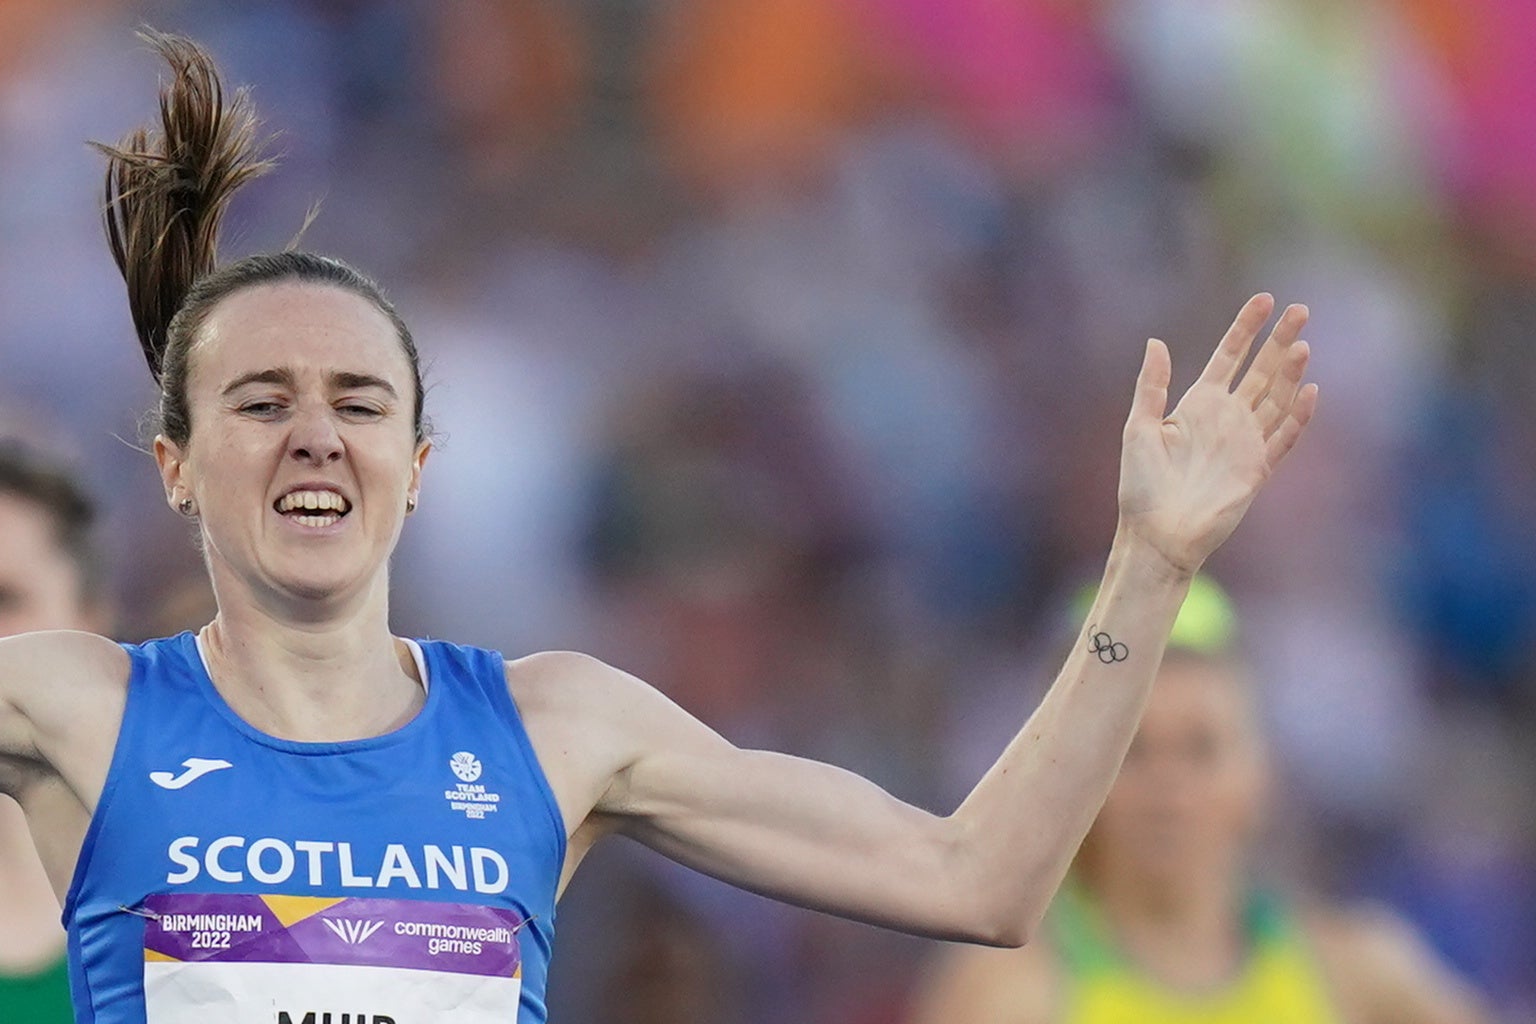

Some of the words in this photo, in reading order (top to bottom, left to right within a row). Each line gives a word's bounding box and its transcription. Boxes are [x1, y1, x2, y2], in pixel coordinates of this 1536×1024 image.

[444, 790, 500, 803] SCOTLAND
[455, 783, 485, 794] TEAM
[166, 836, 509, 894] SCOTLAND
[163, 914, 262, 932] BIRMINGHAM
[191, 931, 231, 949] 2022
[394, 921, 511, 944] commonwealth
[428, 937, 482, 955] games
